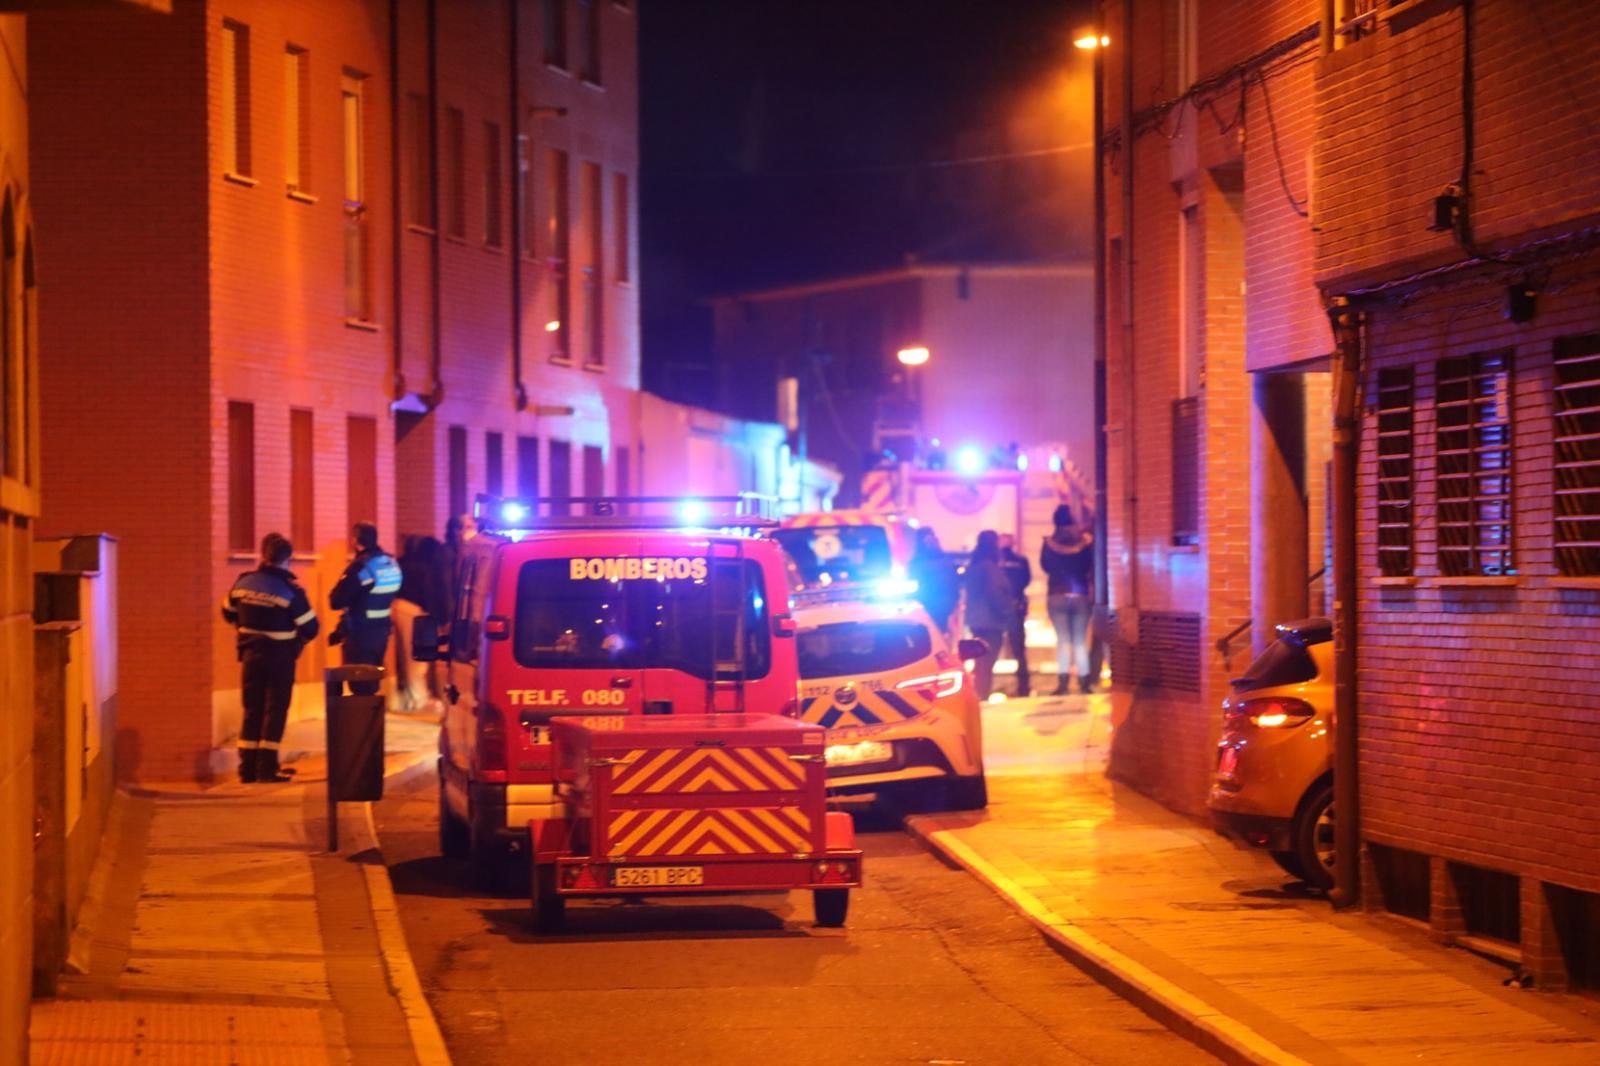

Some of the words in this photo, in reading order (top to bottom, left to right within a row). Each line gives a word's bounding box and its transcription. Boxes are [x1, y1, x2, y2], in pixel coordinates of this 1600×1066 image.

[569, 558, 707, 580] BOMBEROS
[506, 689, 570, 705] TELF.
[582, 689, 625, 705] 080
[620, 869, 659, 885] 5261
[667, 868, 699, 884] BPC
